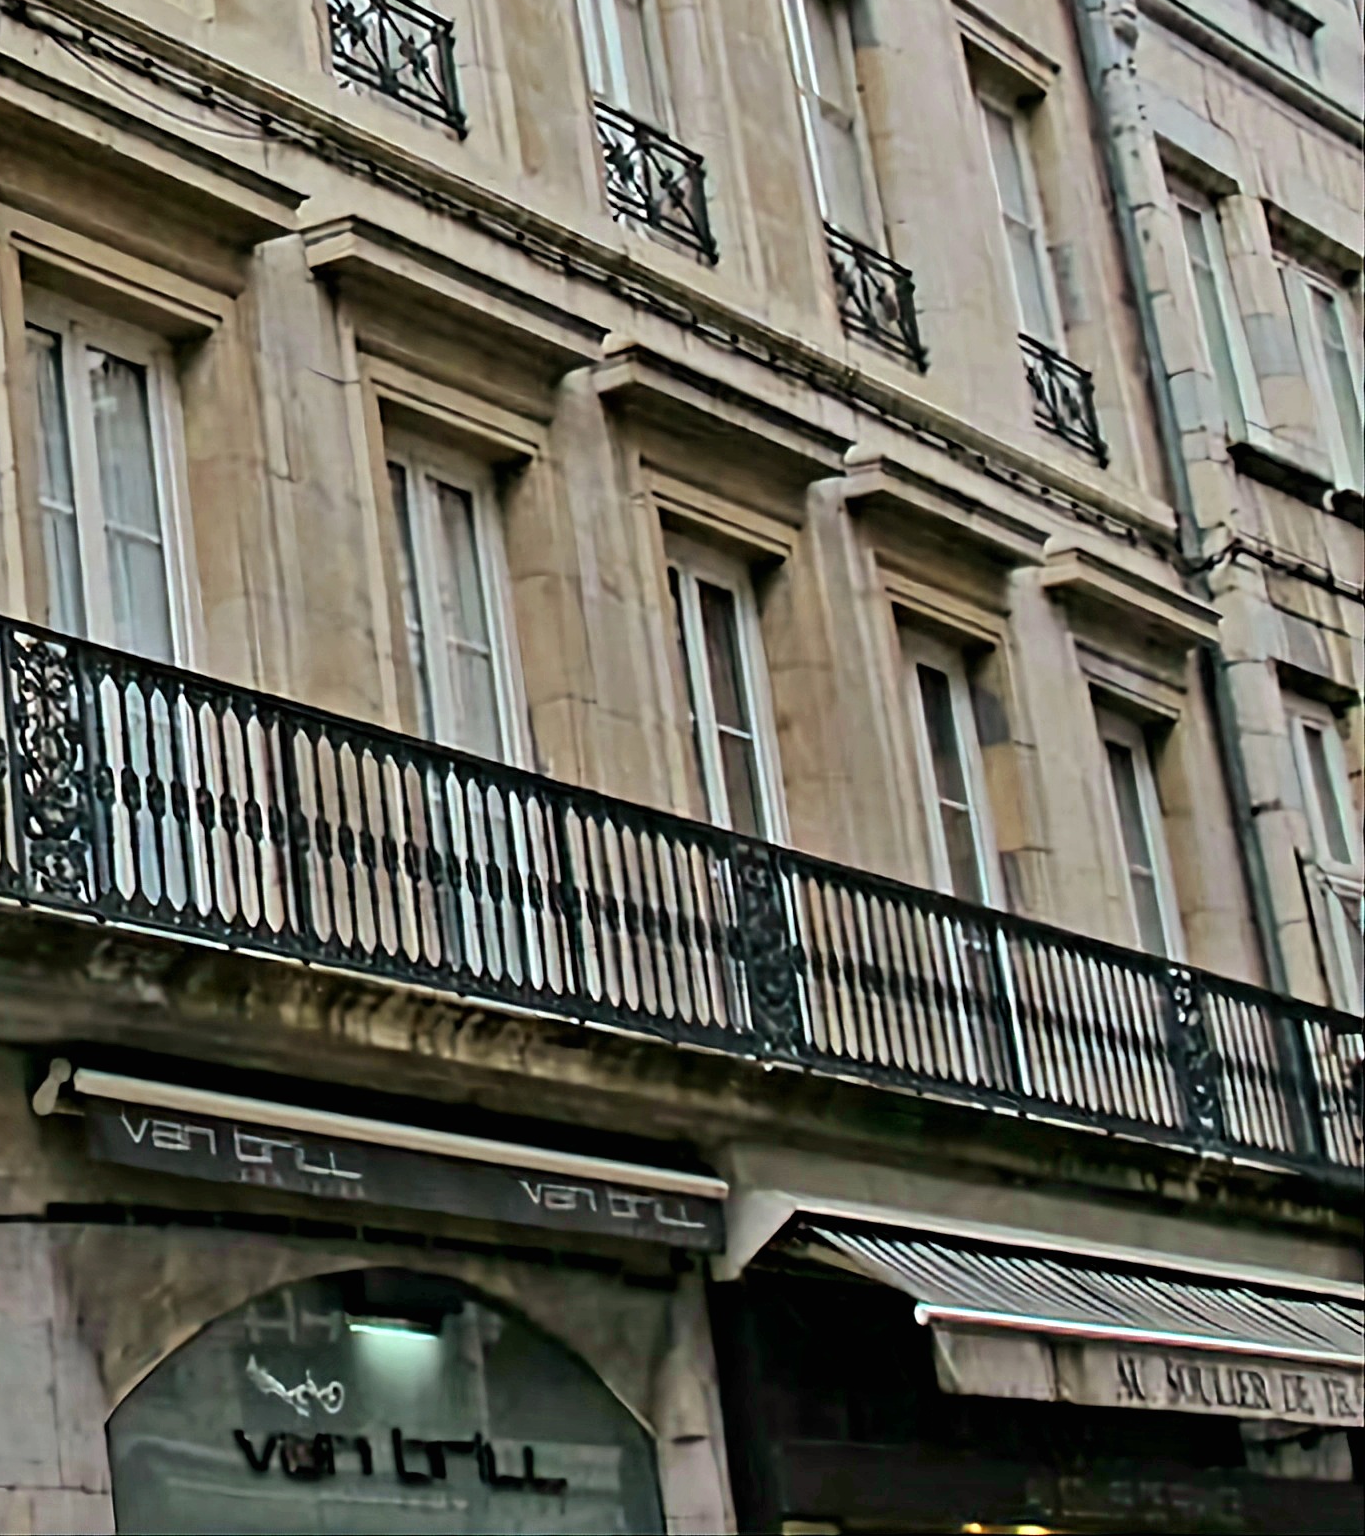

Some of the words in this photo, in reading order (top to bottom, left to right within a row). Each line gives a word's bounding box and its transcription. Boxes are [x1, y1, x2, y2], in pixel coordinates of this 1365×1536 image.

[121, 1106, 217, 1156] van
[518, 1180, 598, 1213] van
[232, 1428, 375, 1482] van
